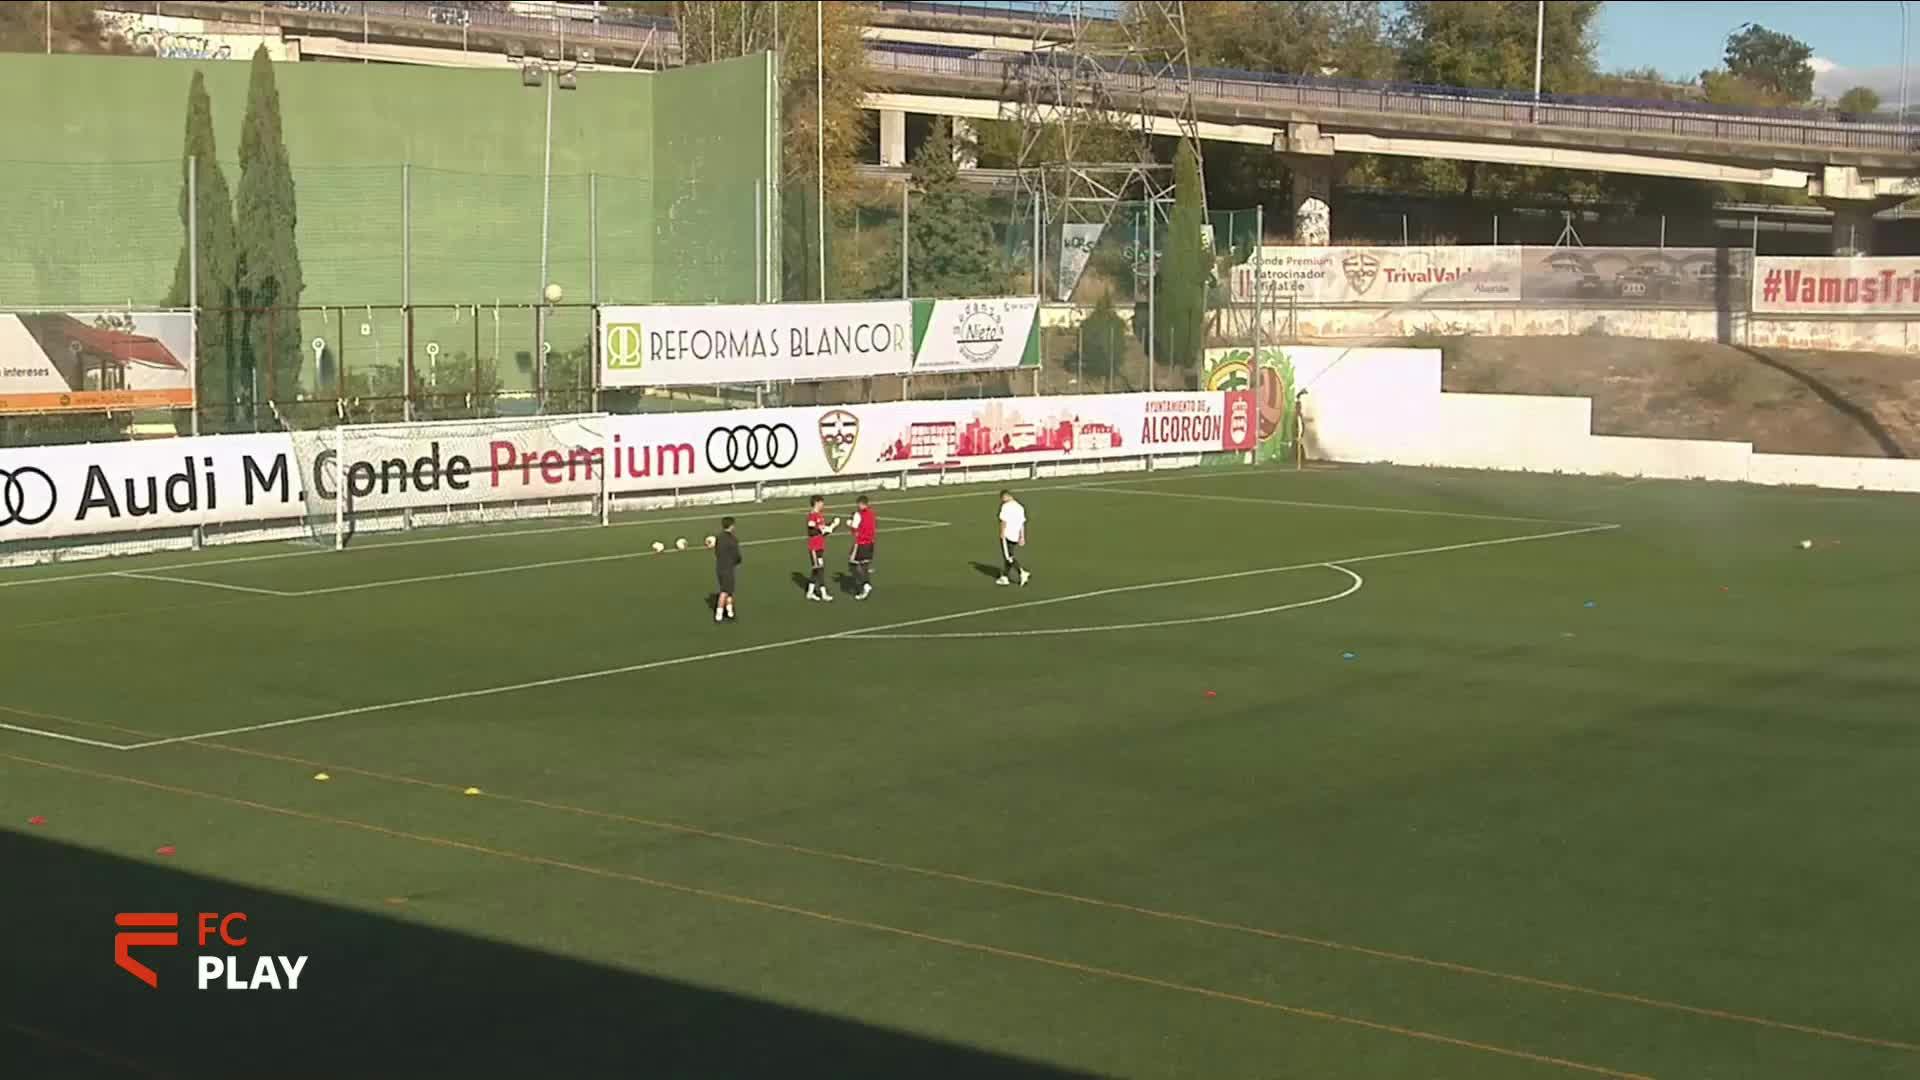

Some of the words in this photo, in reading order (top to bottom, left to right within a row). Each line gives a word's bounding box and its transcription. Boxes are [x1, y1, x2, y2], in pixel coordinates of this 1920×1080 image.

[651, 329, 778, 361] REFORMAS
[790, 323, 905, 358] BLANCOR
[75, 456, 217, 520] Audi
[489, 433, 696, 487] Premium
